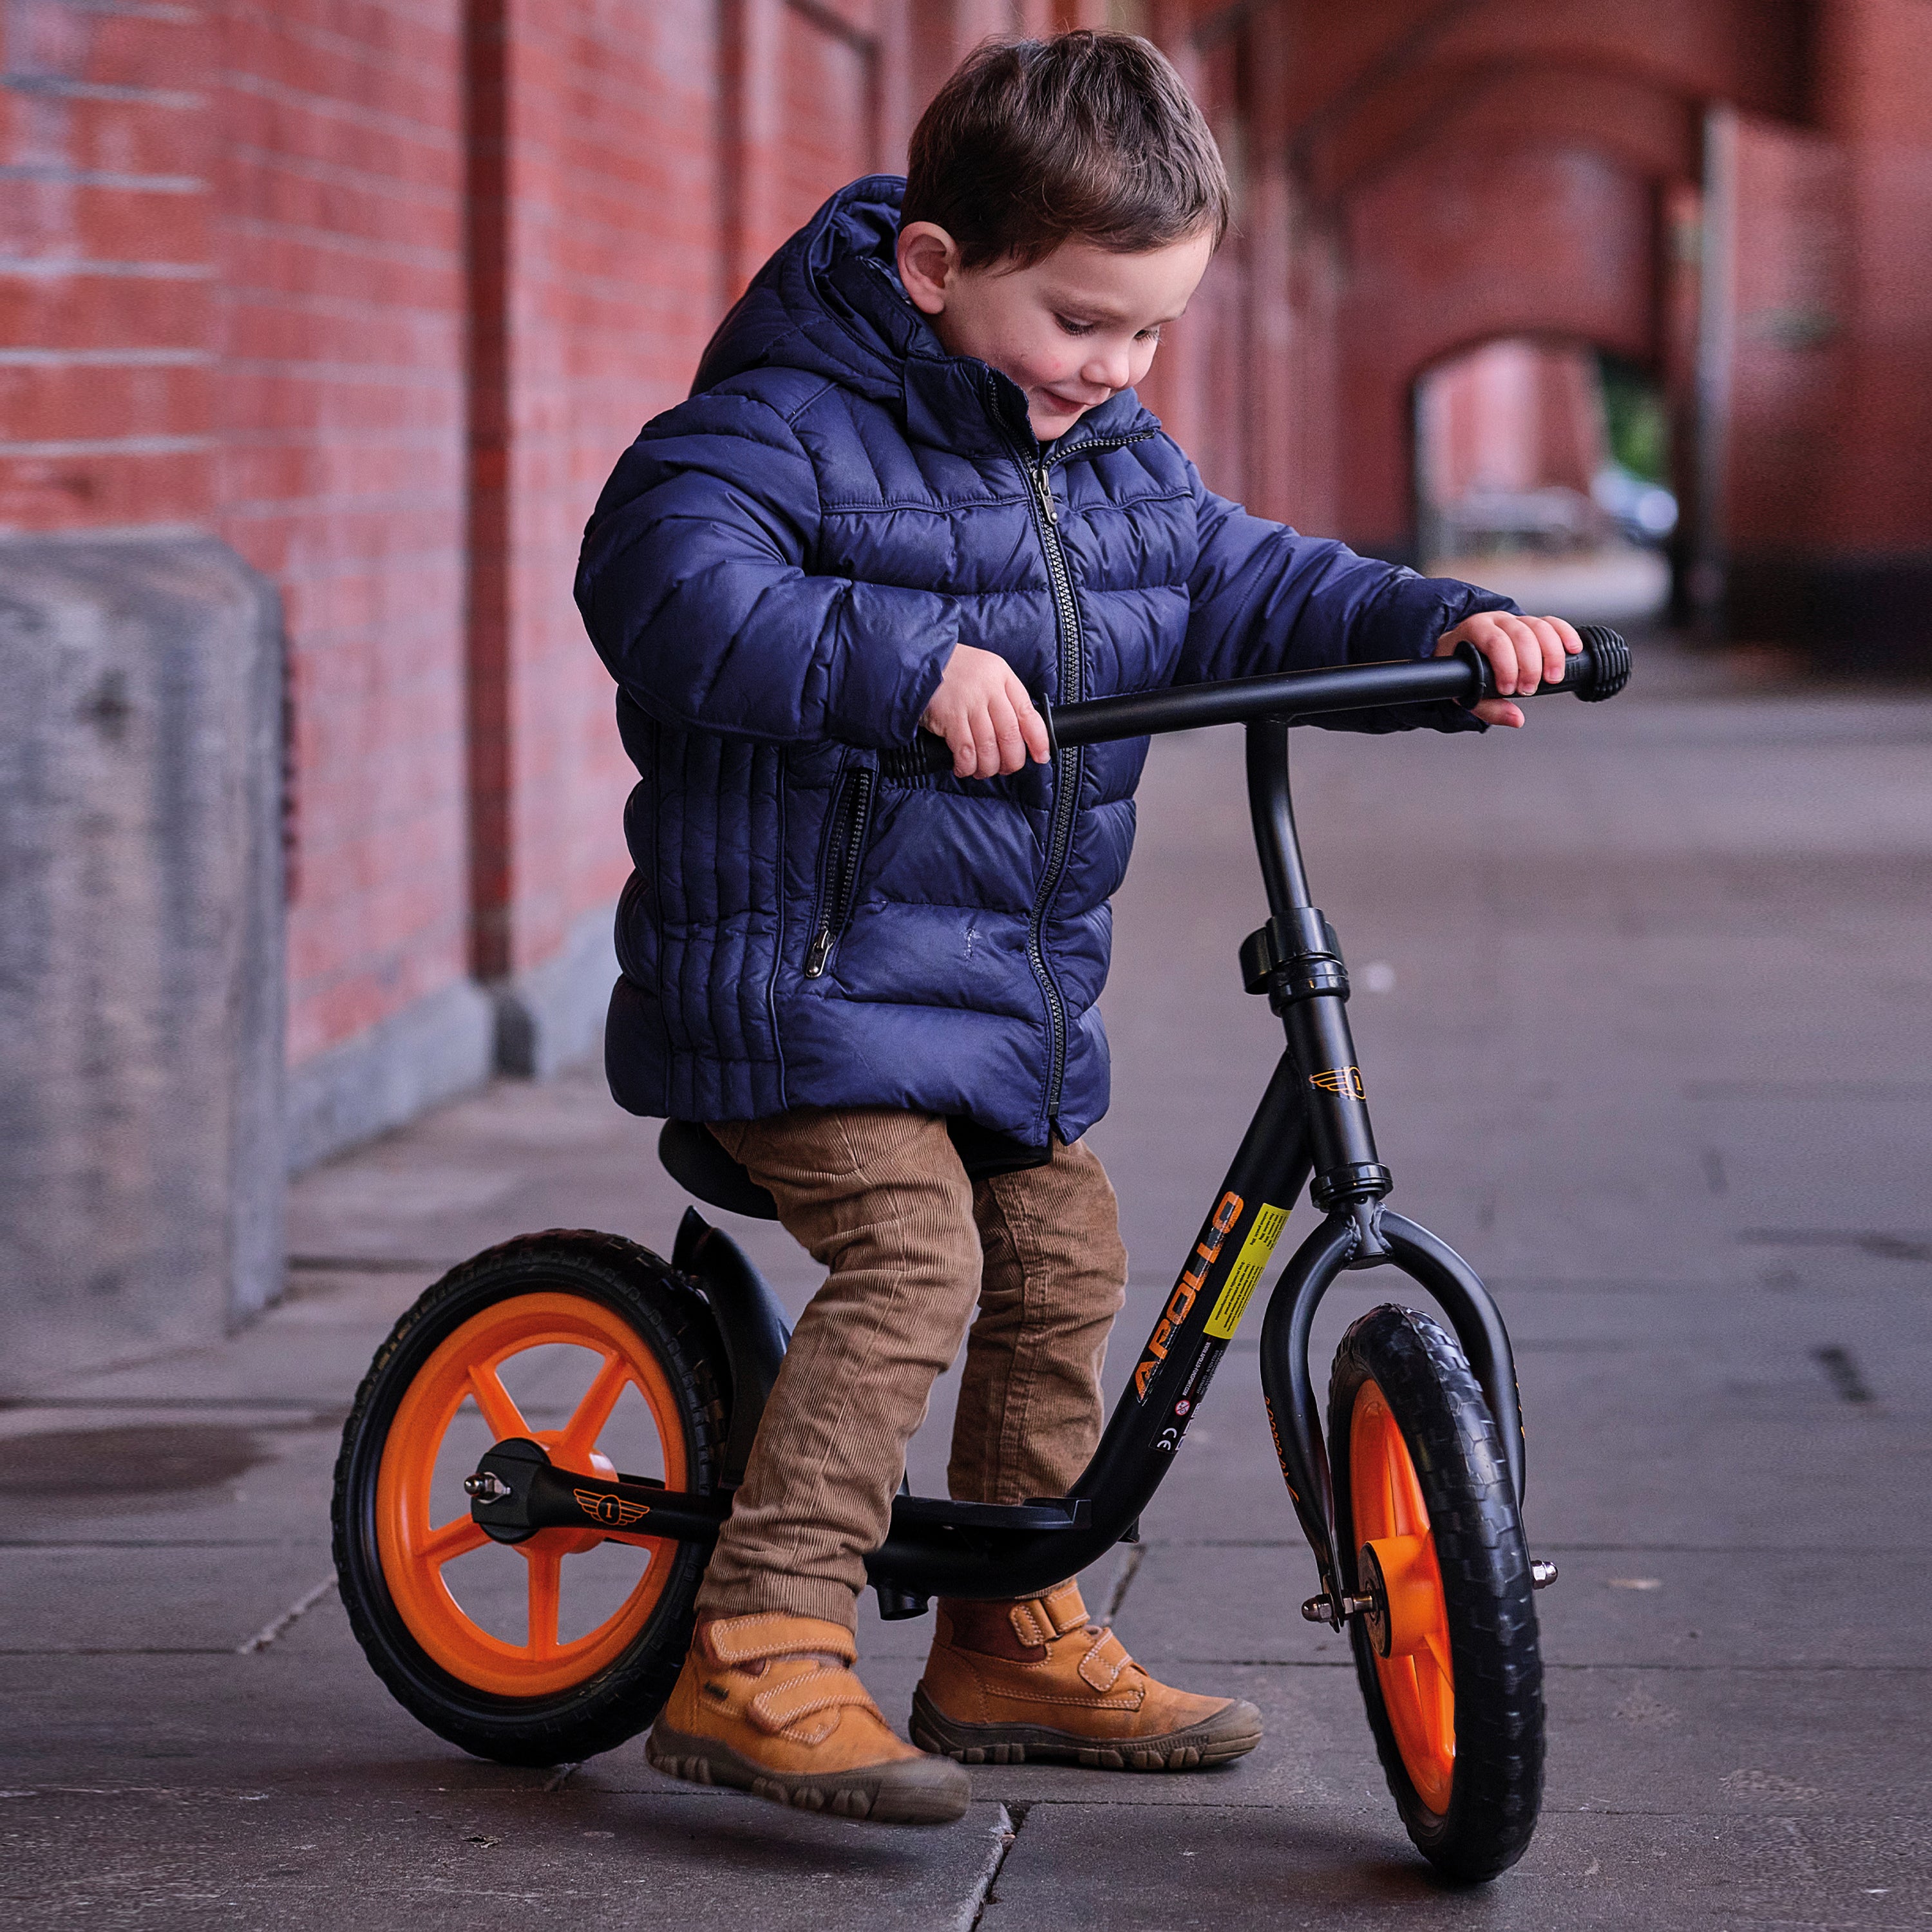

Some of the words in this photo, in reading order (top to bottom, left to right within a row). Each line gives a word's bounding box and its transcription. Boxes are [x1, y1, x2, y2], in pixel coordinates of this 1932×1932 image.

[1135, 1191, 1244, 1401] APOLLO
[1157, 1427, 1178, 1450] CE
[605, 1502, 612, 1518] 1
